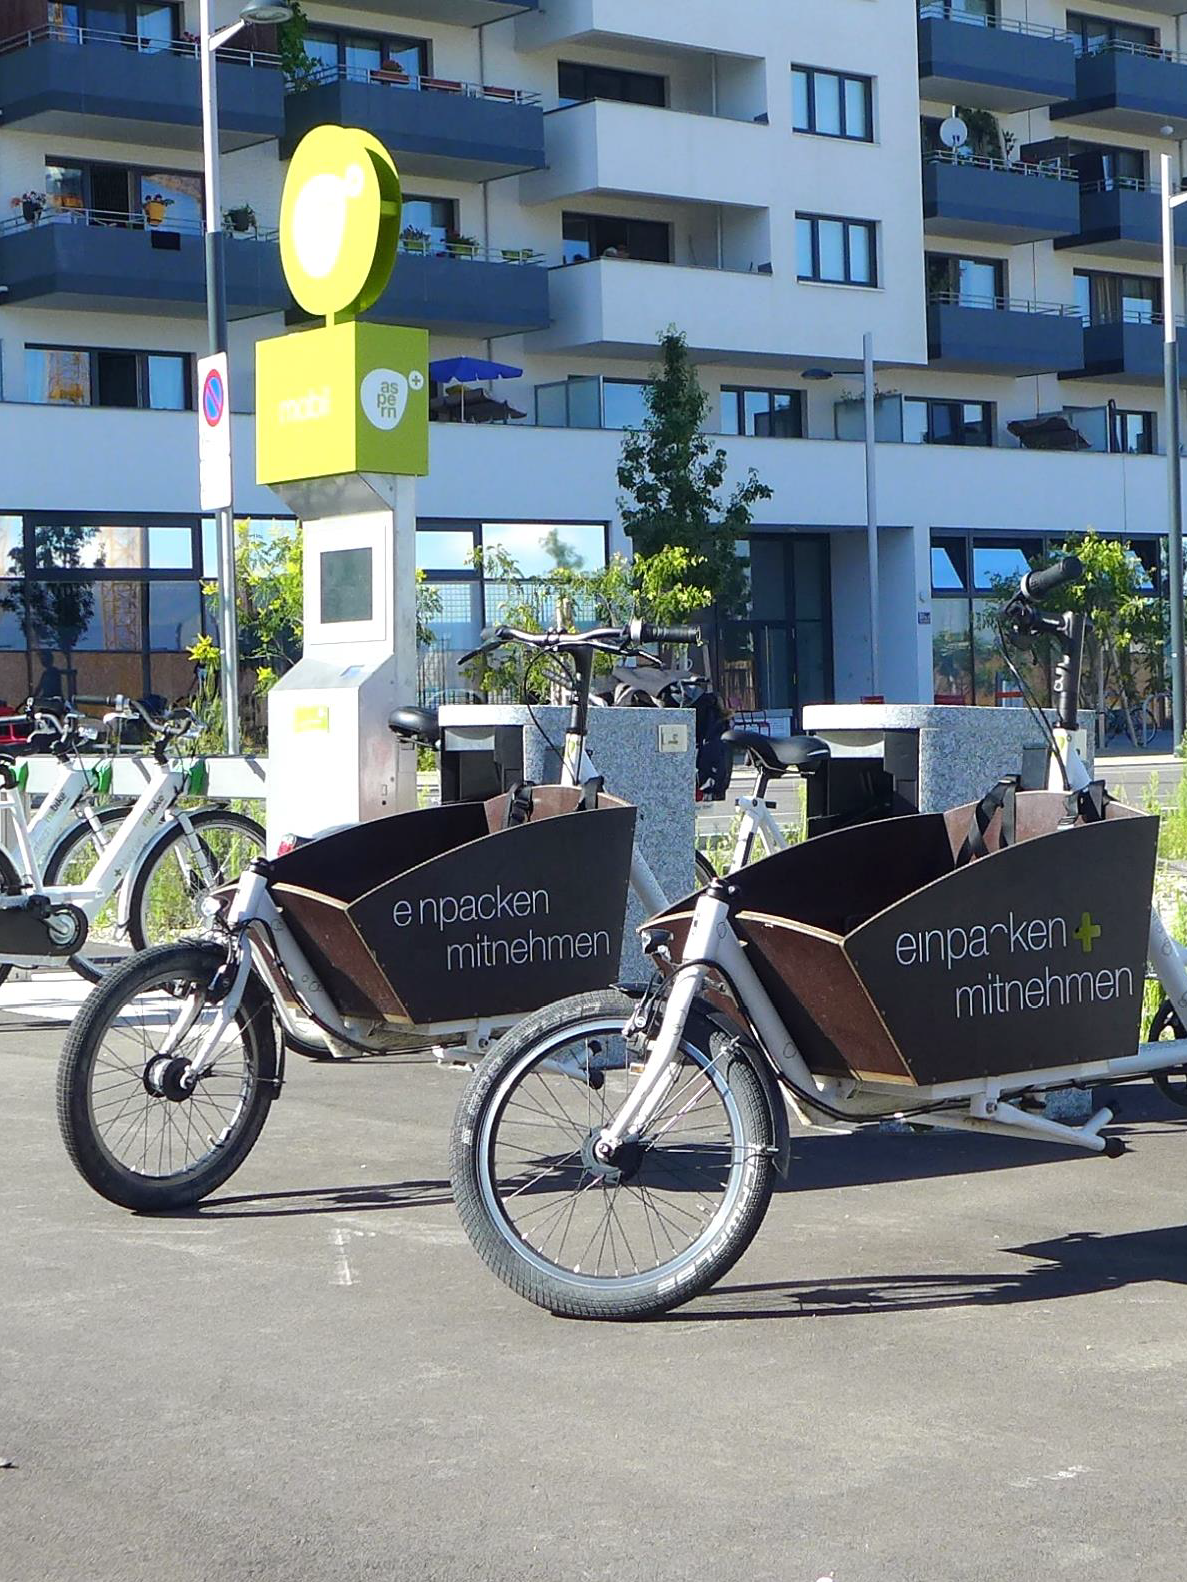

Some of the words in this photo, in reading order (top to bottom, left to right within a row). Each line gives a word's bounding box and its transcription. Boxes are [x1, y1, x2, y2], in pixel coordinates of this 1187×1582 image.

[377, 393, 397, 408] pe
[381, 381, 399, 394] as
[381, 406, 397, 418] rn
[393, 884, 549, 931] enpacken
[447, 929, 610, 971] mitnehmen
[956, 966, 1133, 1018] mitnehmen
